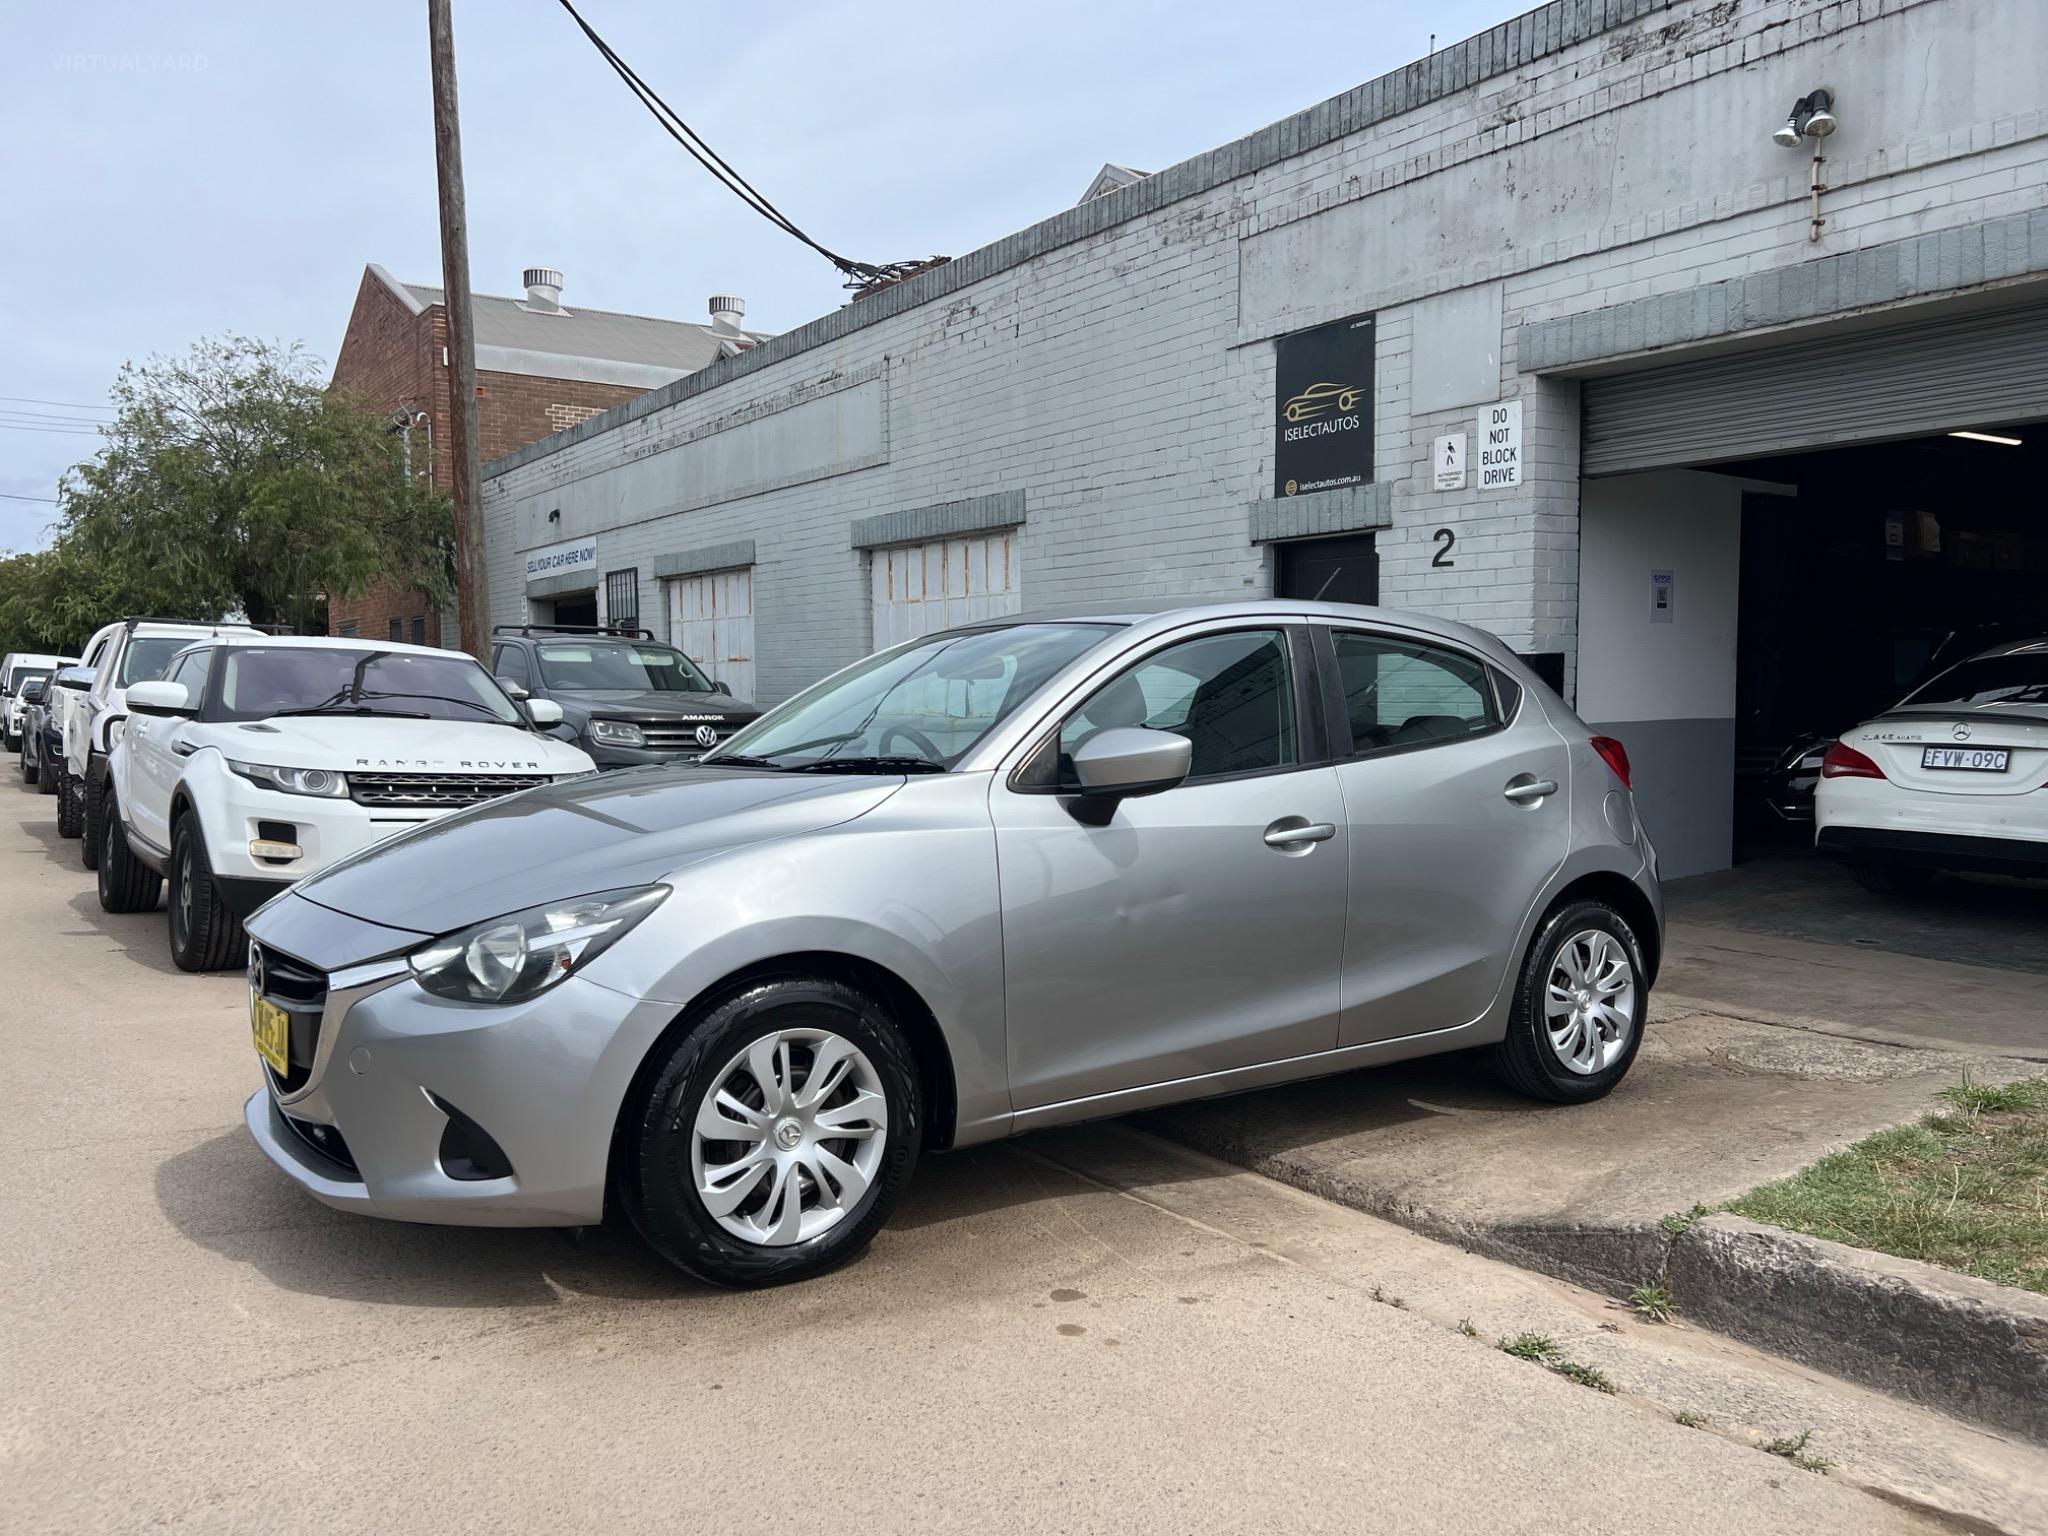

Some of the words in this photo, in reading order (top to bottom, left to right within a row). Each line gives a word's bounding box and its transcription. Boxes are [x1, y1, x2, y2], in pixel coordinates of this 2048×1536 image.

[1492, 408, 1508, 424] DO
[1284, 415, 1360, 442] ISELECTAUTOS
[1489, 428, 1510, 445] NOT
[1482, 446, 1517, 466] BLOCK
[1299, 475, 1361, 491] iselectautos.com.au
[1484, 467, 1515, 485] DRIVE
[1431, 527, 1456, 568] 2
[527, 560, 538, 573] SELL
[538, 557, 551, 571] YOUR
[552, 554, 565, 568] CAR
[565, 550, 579, 566] HERE
[460, 761, 539, 769] ROVER
